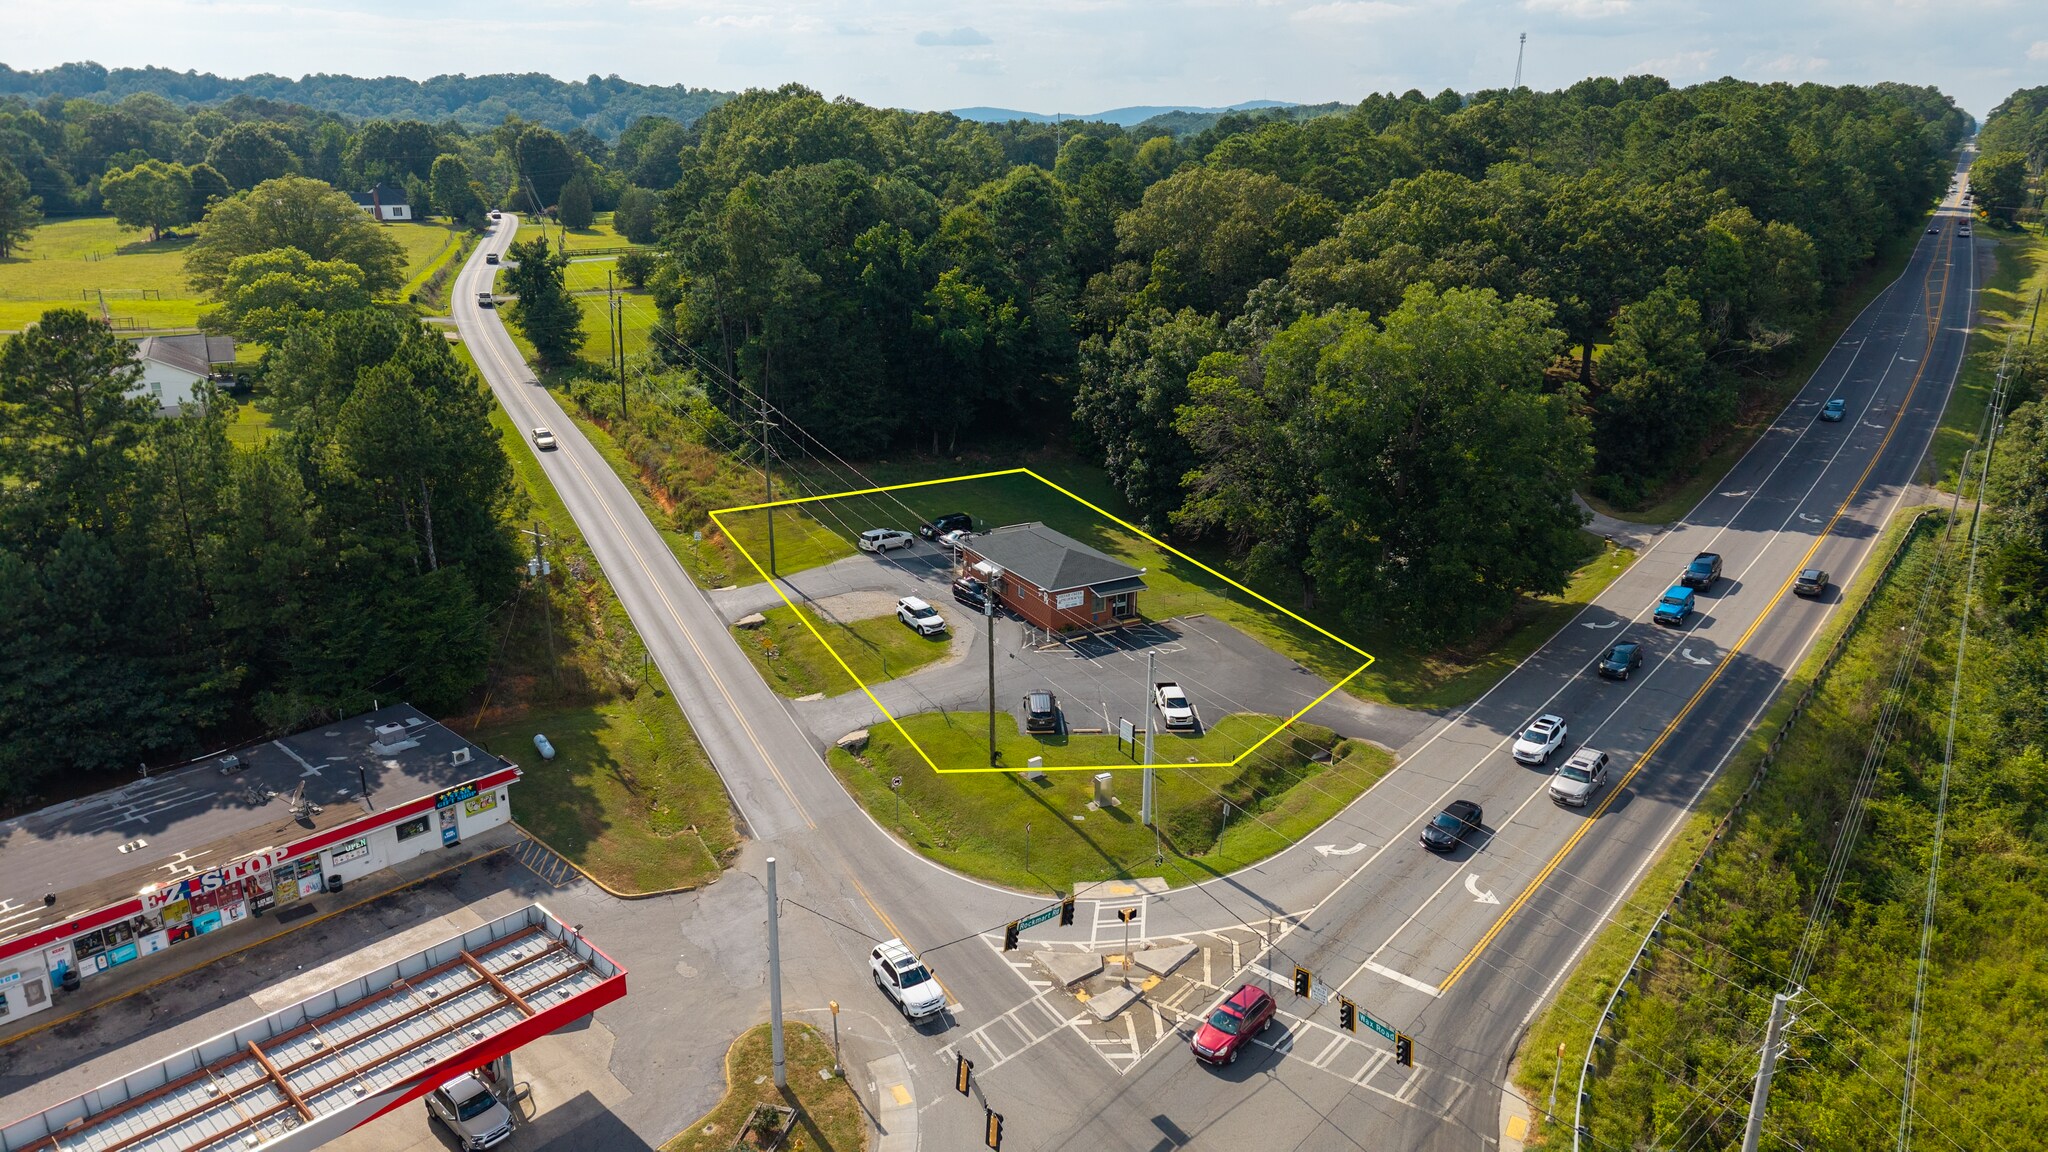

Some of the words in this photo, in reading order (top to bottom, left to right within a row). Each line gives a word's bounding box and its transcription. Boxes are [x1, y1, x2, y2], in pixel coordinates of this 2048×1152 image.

[437, 797, 455, 809] GIFT
[457, 790, 477, 802] SHOP
[138, 882, 185, 912] EZ
[200, 847, 288, 892] STOP
[1019, 912, 1051, 930] Rockmart
[1051, 907, 1060, 917] Rd
[1359, 1014, 1374, 1028] Wax
[1376, 1024, 1395, 1041] Road
